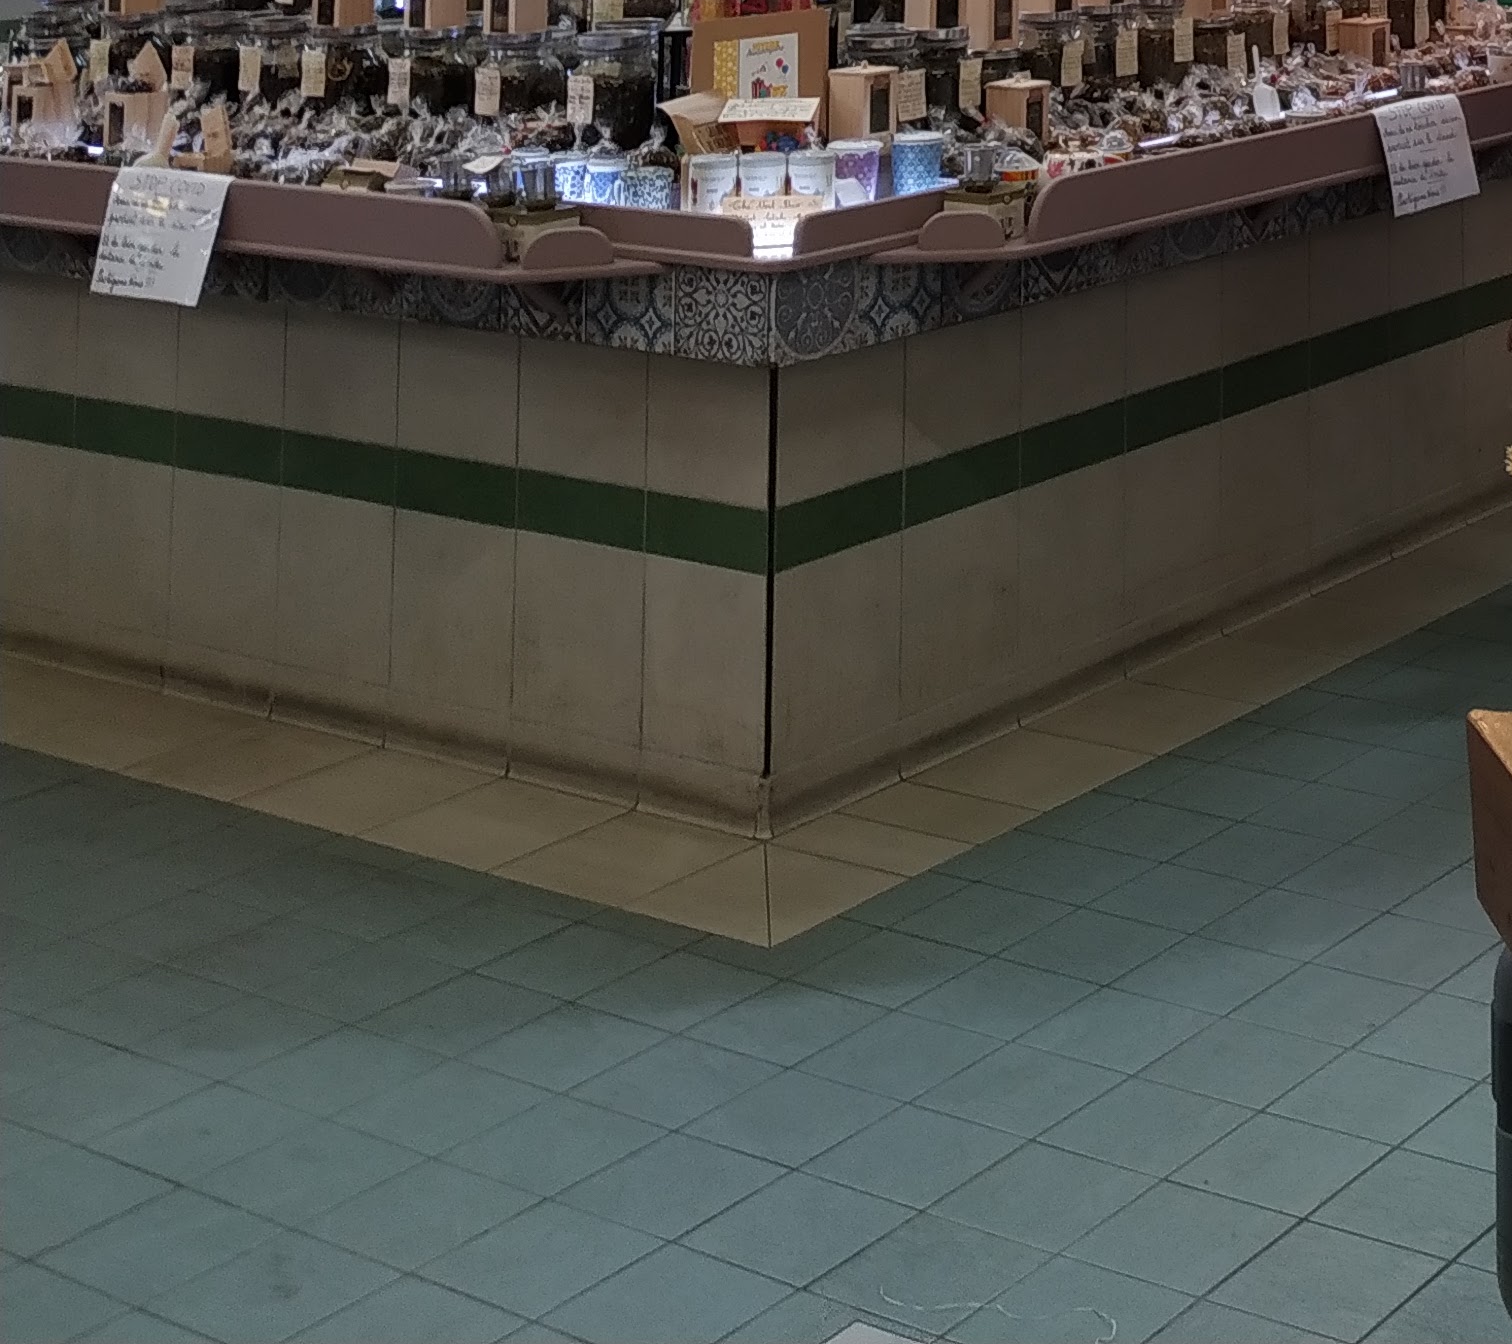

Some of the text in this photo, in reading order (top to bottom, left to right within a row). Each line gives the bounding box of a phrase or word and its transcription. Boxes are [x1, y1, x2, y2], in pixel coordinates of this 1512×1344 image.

[1388, 99, 1446, 120] STOP COVID
[129, 174, 168, 191] STOP
